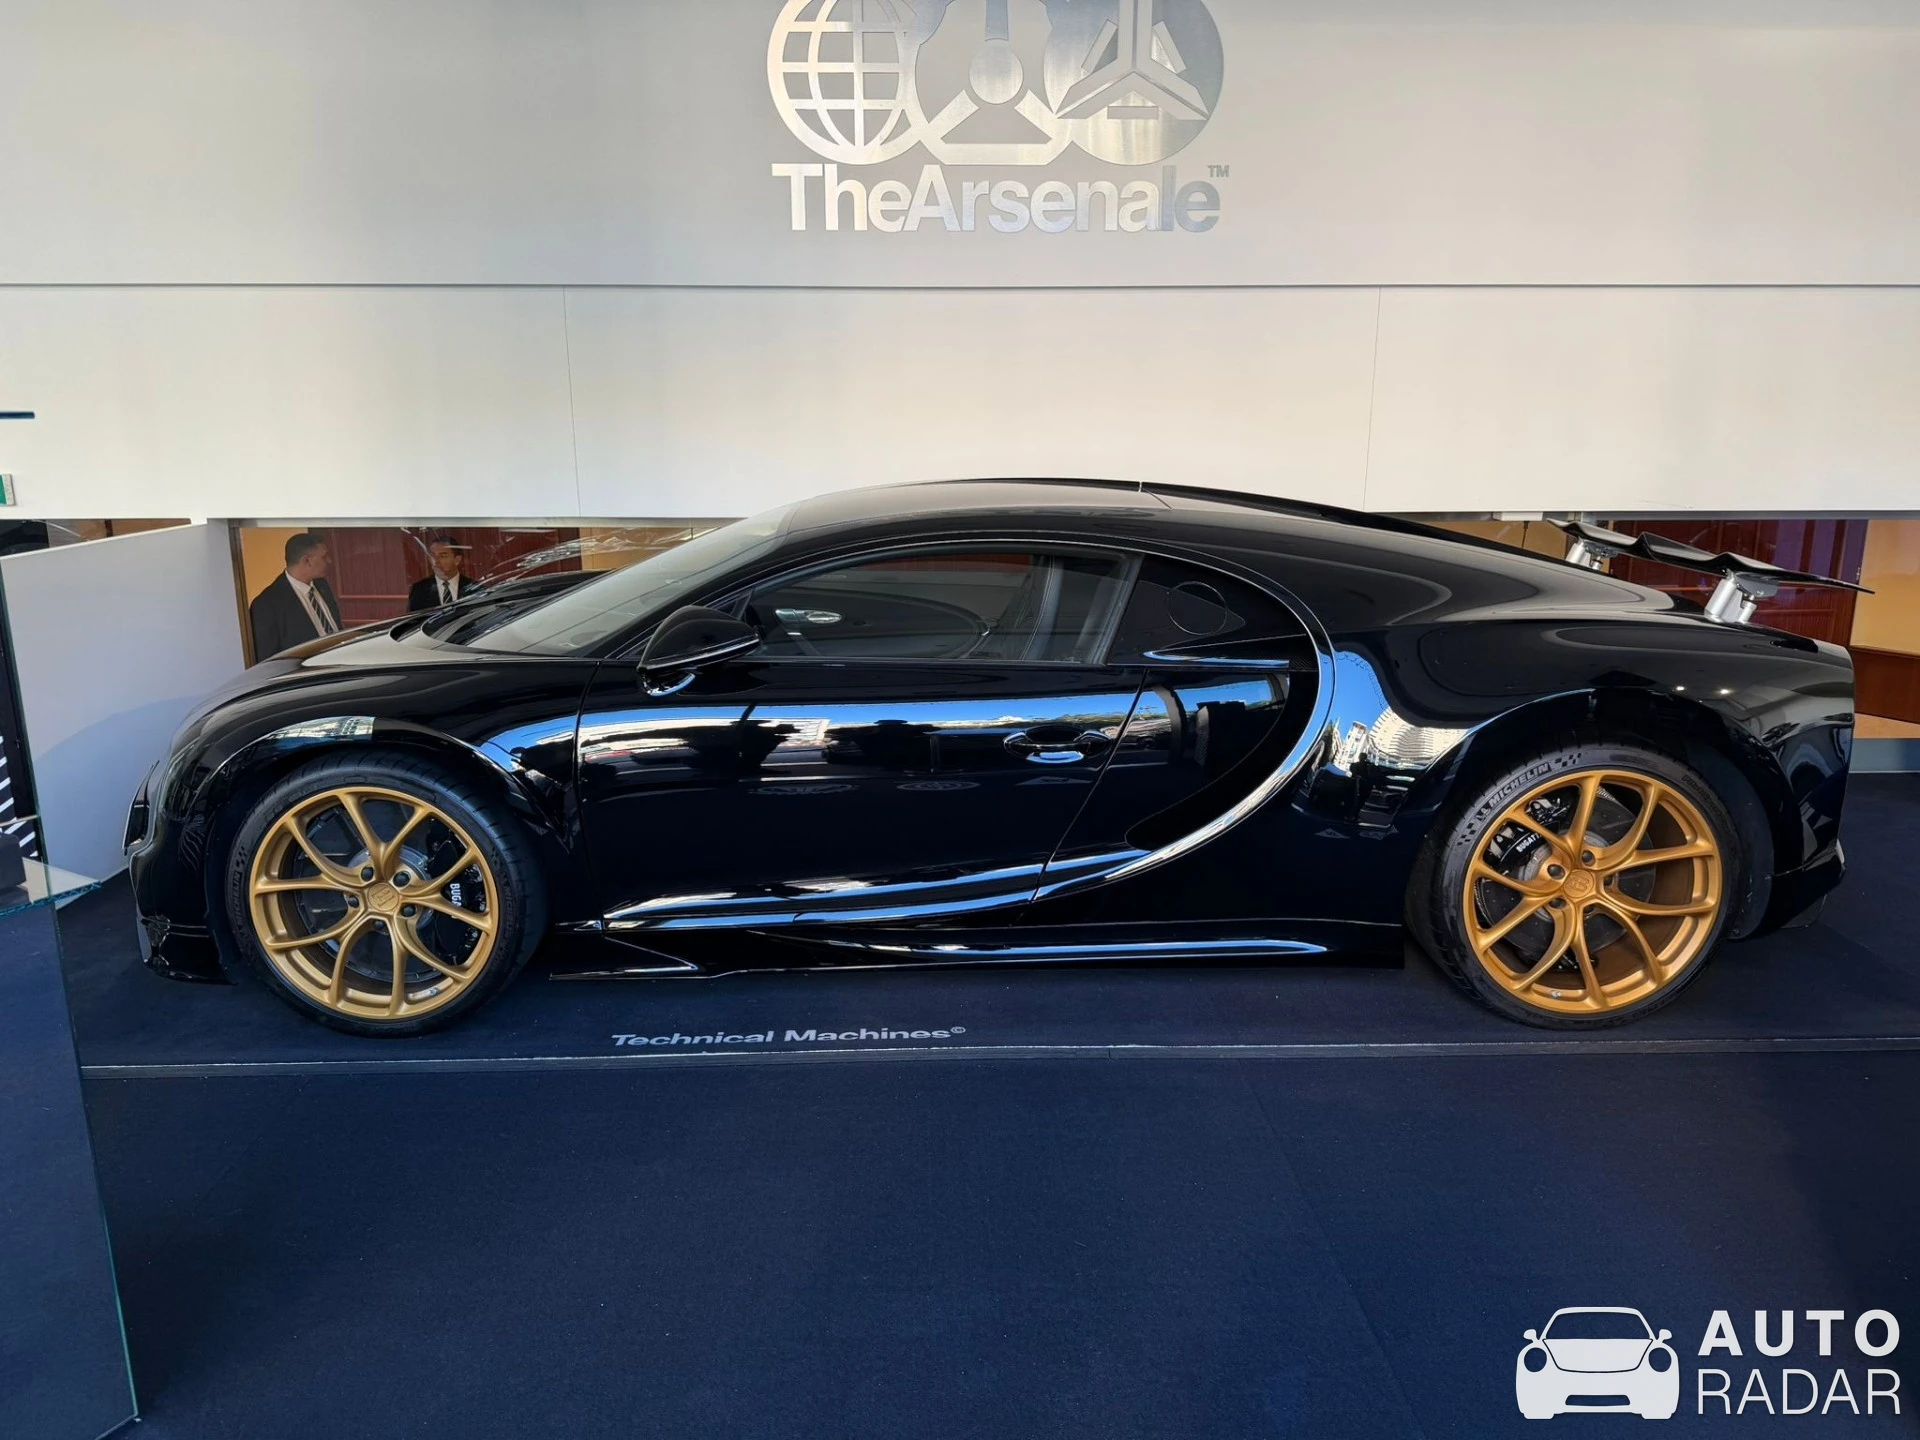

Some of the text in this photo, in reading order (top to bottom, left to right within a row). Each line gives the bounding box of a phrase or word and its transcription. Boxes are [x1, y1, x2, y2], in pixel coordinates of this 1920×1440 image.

[771, 163, 1221, 233] TheArsenale
[1488, 762, 1549, 808] MICHELIN
[1516, 832, 1541, 852] BUGATT
[611, 1030, 774, 1046] Technical
